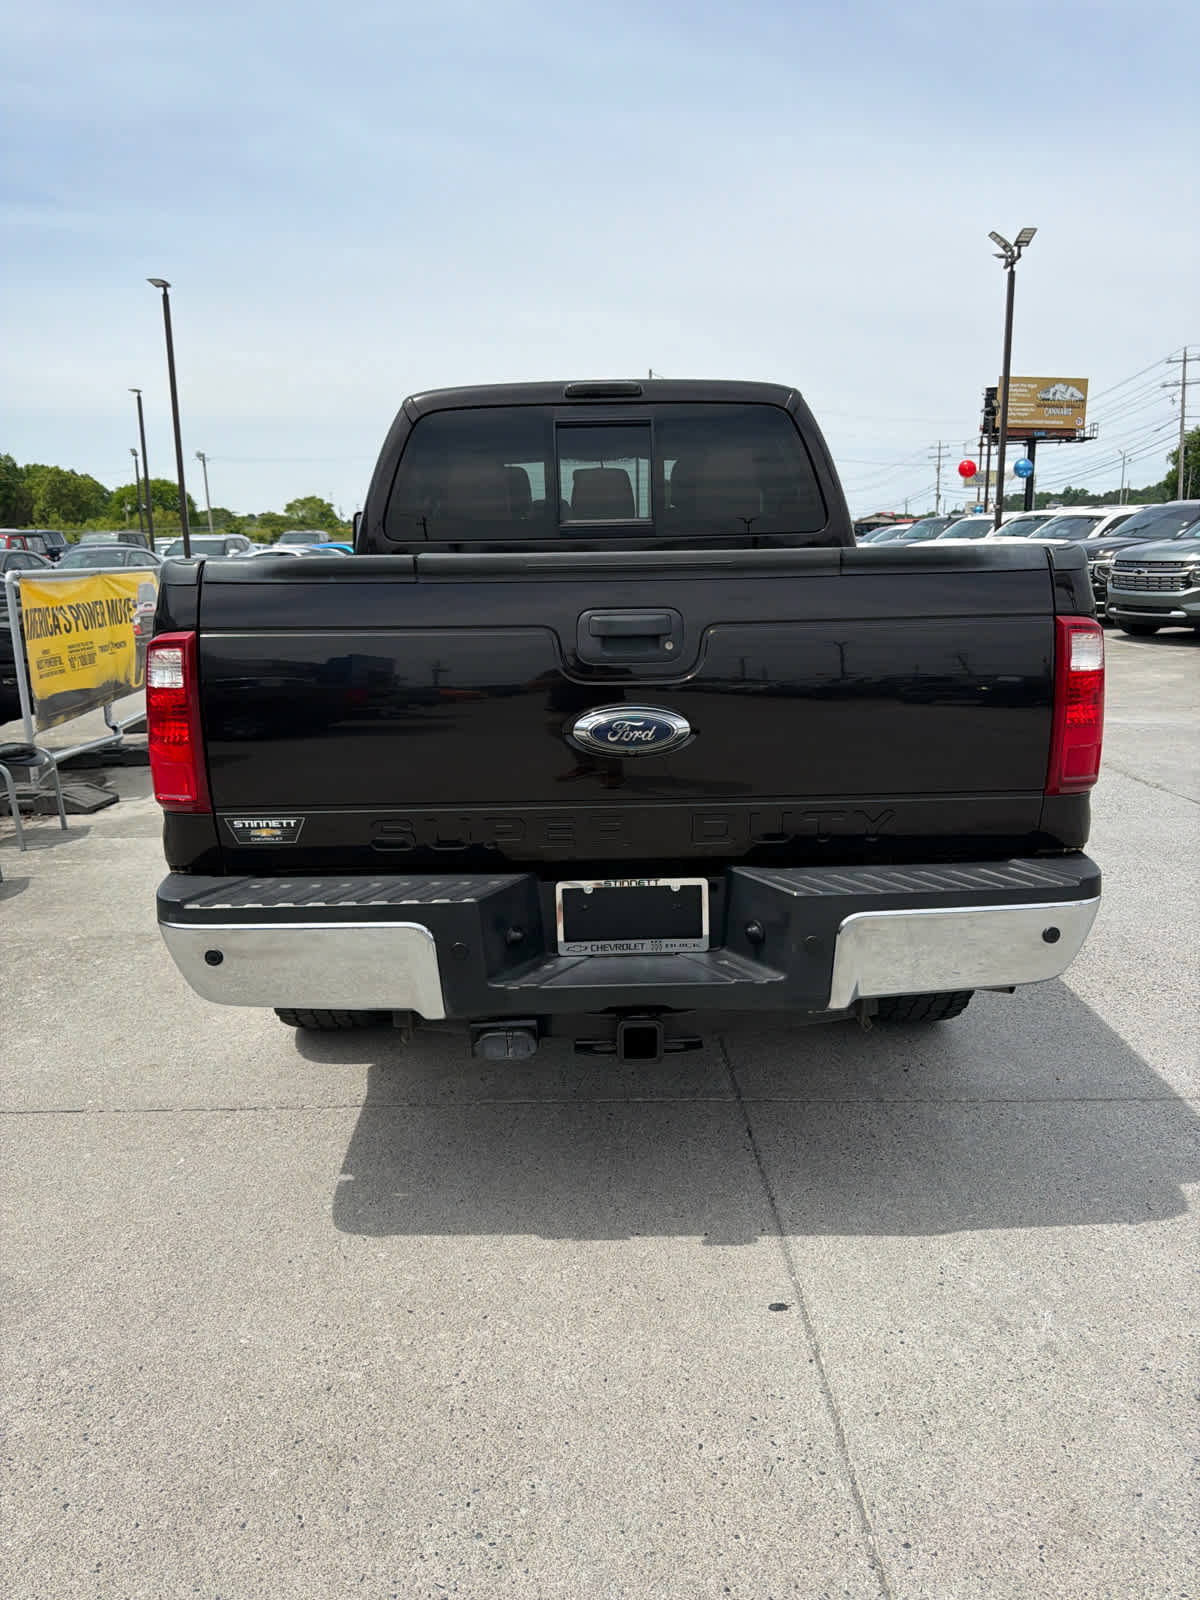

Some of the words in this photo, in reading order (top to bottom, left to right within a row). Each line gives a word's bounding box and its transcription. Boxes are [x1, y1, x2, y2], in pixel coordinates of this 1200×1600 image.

[25, 605, 72, 640] AMERICA'S
[68, 600, 107, 632] POWER
[107, 598, 134, 625] MOVE
[607, 720, 656, 742] Ford
[233, 819, 297, 828] STINNETT
[690, 809, 897, 848] DUTY
[604, 879, 660, 888] STINNETT
[590, 942, 646, 952] CHEVROLET
